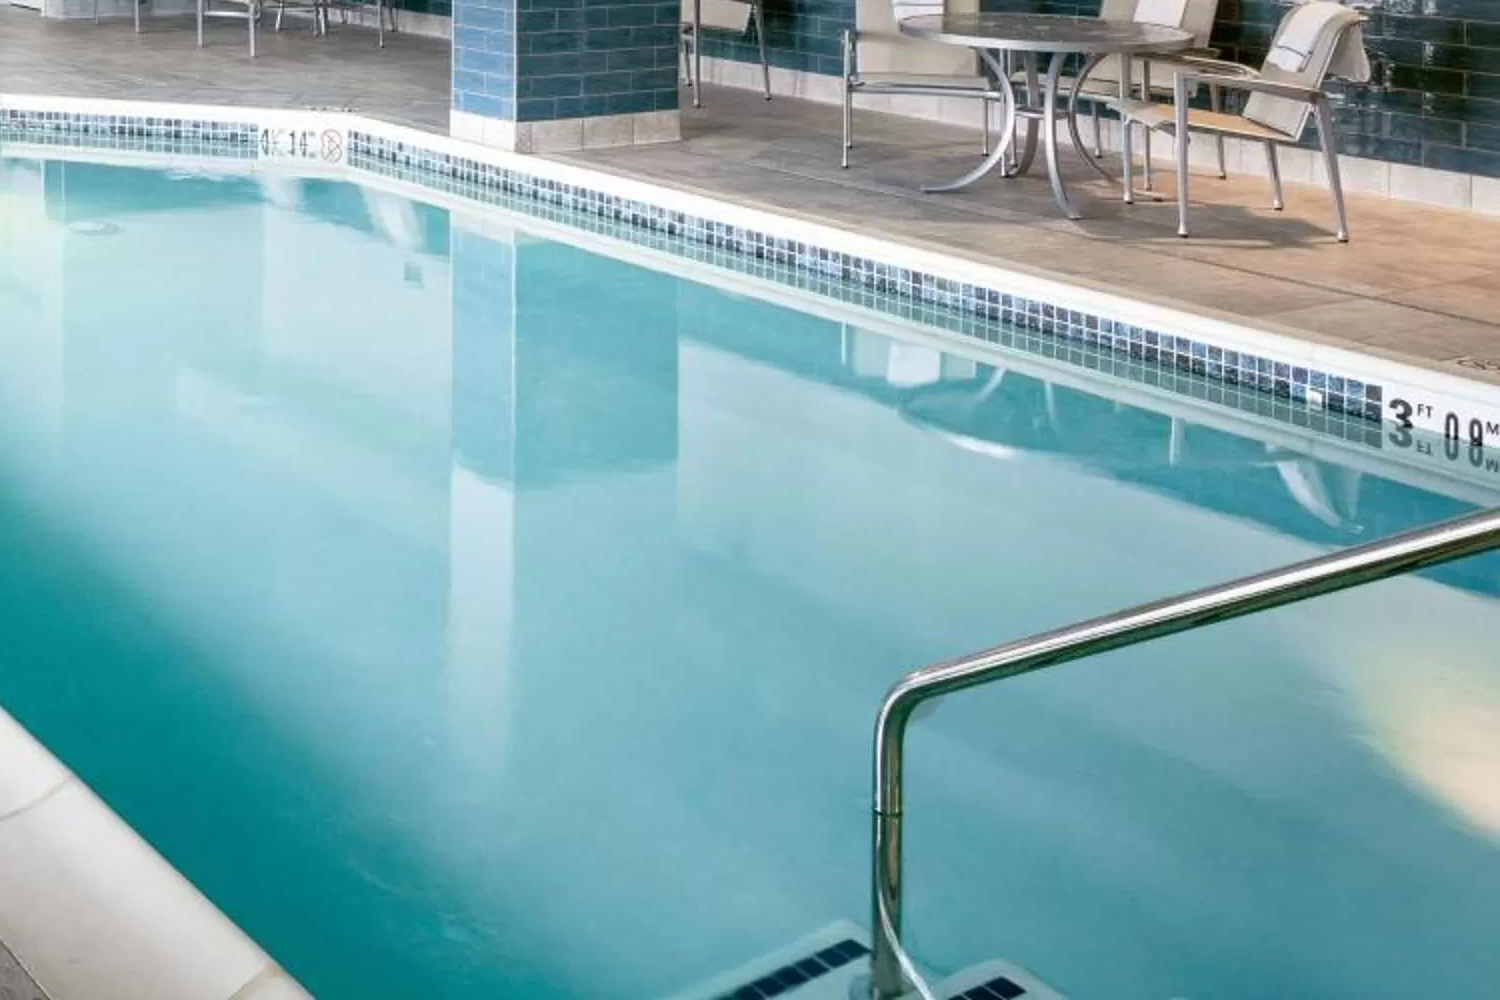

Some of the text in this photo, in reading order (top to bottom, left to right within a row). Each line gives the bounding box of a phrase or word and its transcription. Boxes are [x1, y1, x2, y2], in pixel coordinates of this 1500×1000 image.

[1388, 398, 1414, 430] 3
[1417, 403, 1433, 419] FT
[1485, 421, 1499, 436] M
